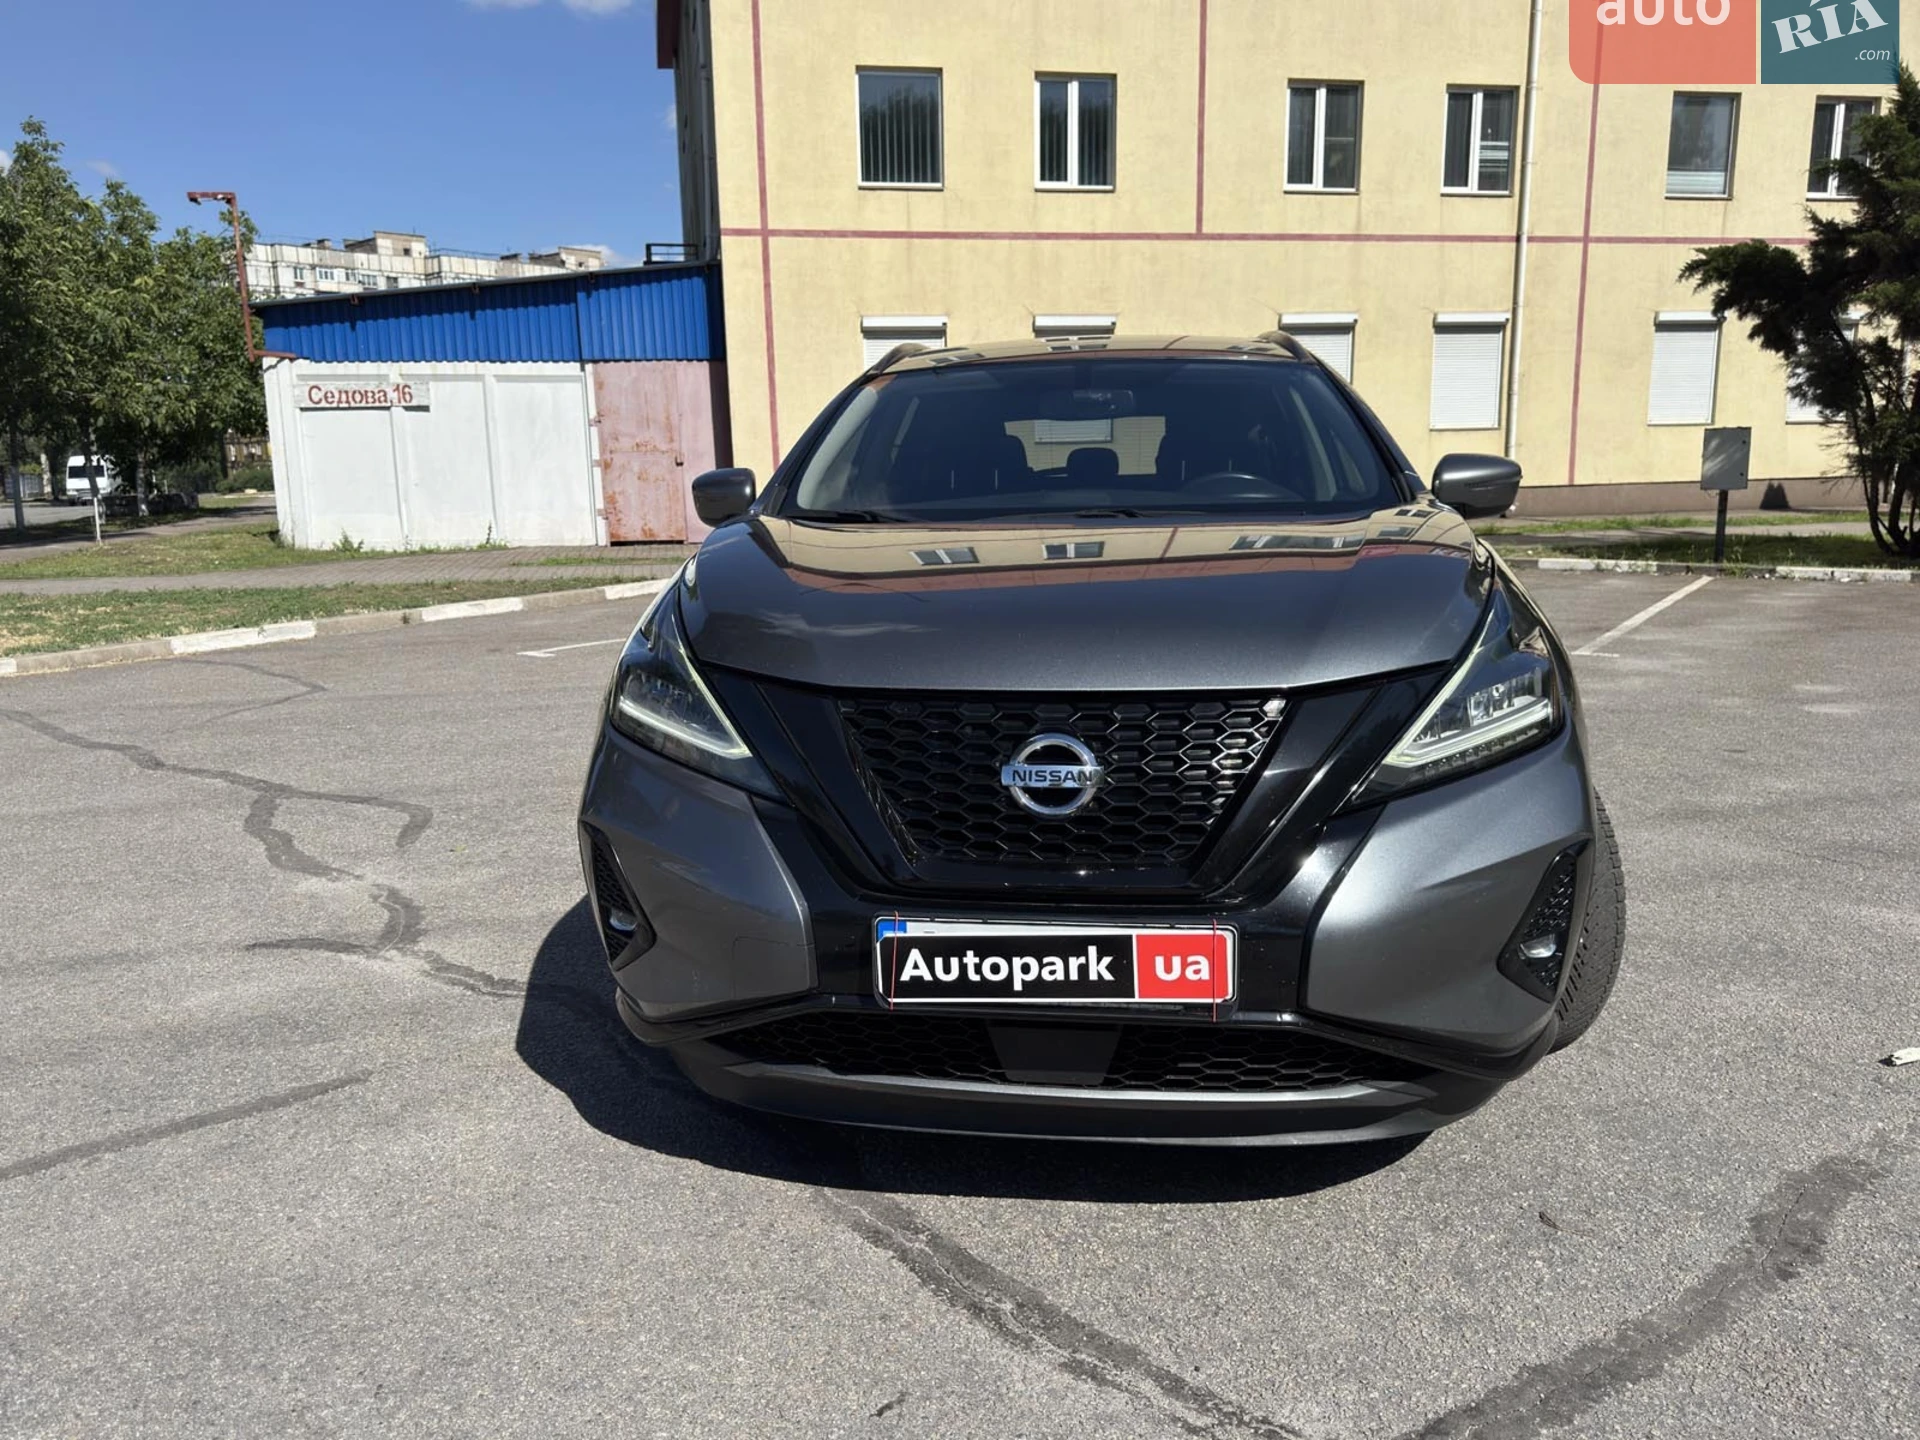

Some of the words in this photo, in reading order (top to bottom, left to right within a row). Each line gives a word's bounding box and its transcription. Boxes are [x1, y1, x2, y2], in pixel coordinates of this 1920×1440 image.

[1012, 769, 1093, 783] NISSAN
[900, 945, 1115, 991] Autopark
[1155, 954, 1211, 981] ua
